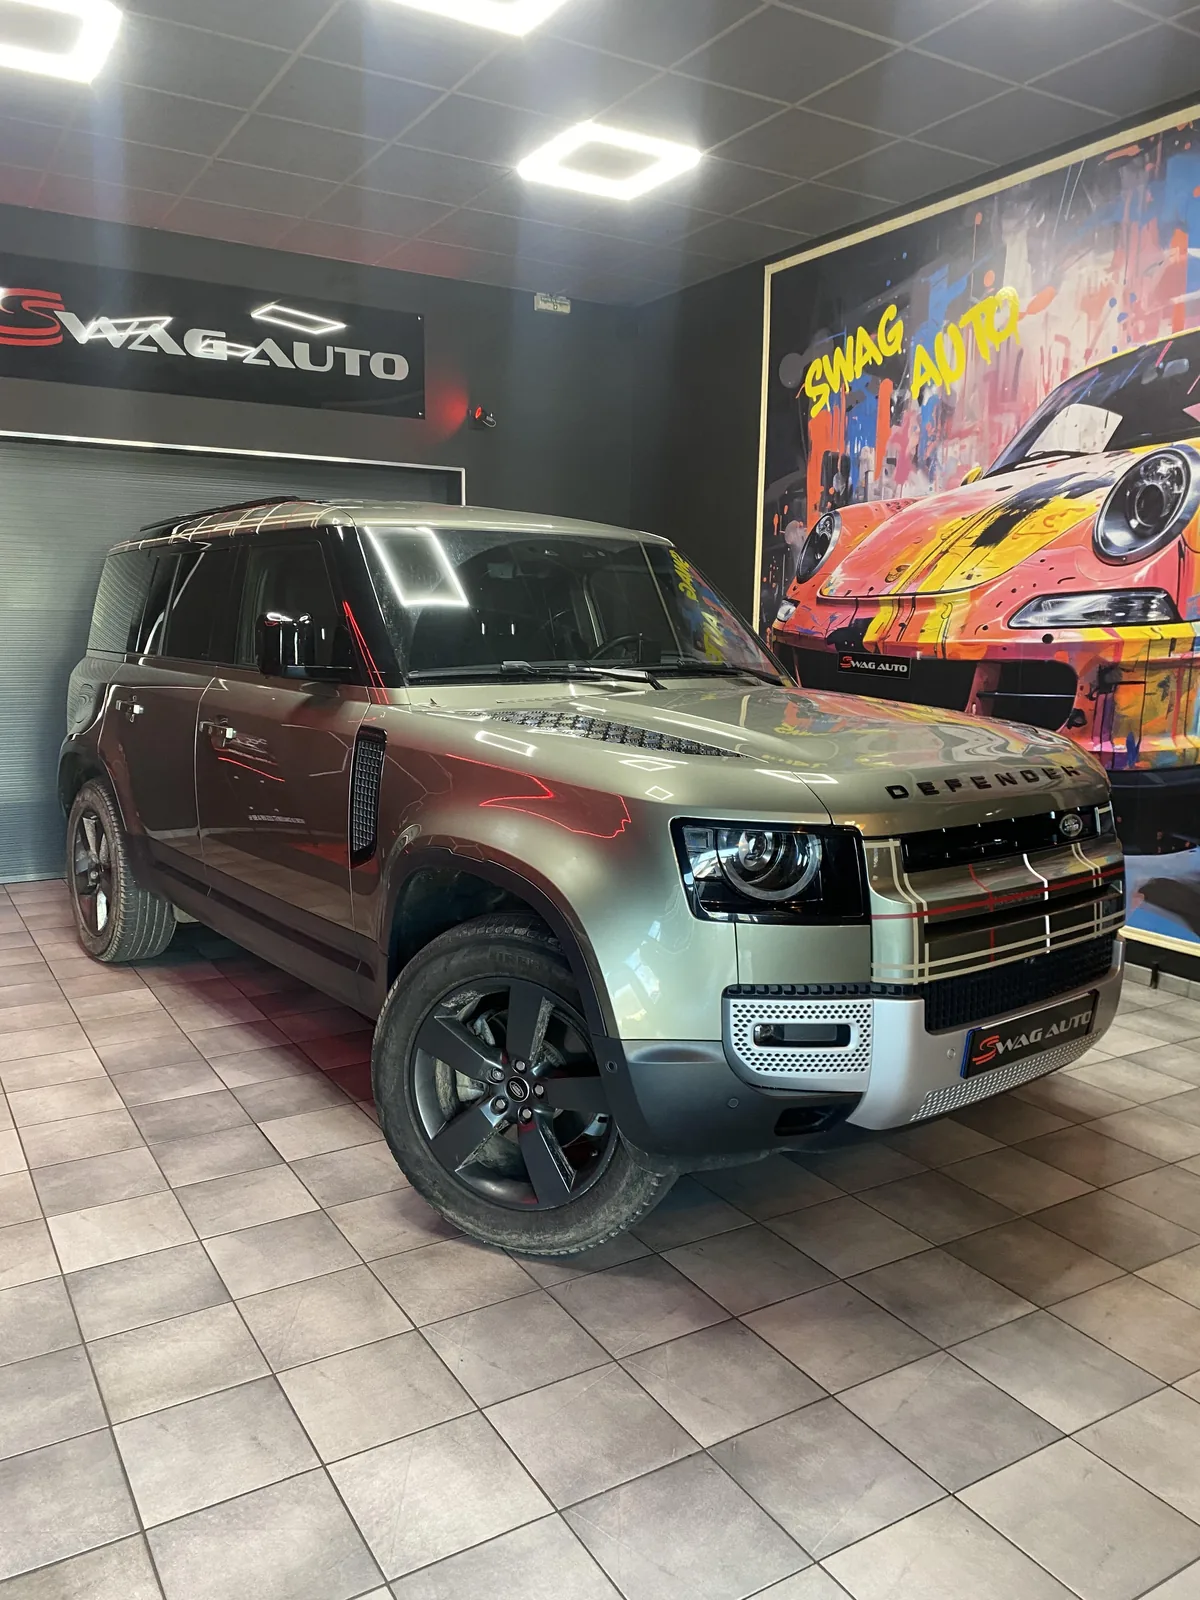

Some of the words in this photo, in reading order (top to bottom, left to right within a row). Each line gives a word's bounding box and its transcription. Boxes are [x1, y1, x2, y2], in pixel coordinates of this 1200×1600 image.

[0, 287, 227, 360] SWAG
[243, 338, 410, 381] AUTO
[804, 303, 904, 418] SWAG
[910, 286, 1021, 400] AUTO
[840, 656, 876, 670] SWAG
[877, 663, 908, 673] AUTO
[884, 765, 1081, 800] DEFENDER
[972, 1028, 1043, 1066] SWAG
[1044, 1010, 1092, 1040] AUTO
